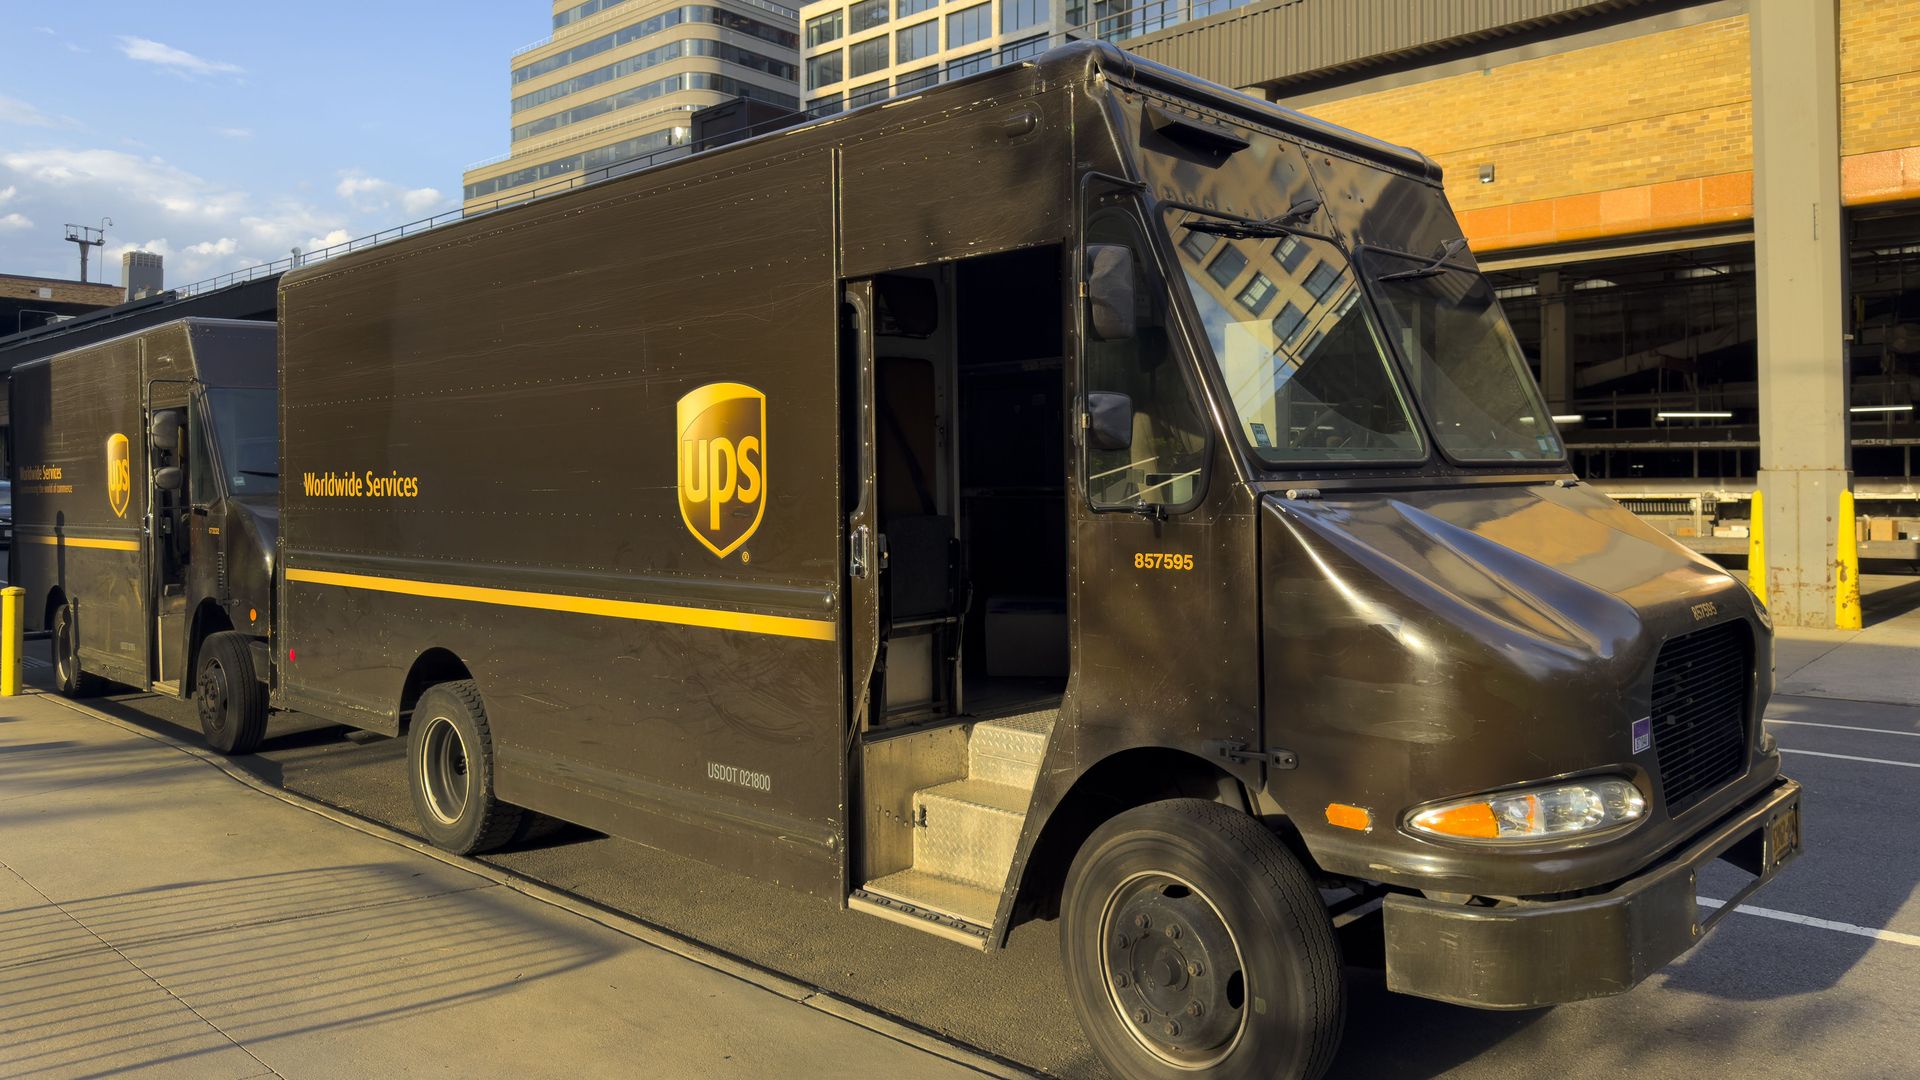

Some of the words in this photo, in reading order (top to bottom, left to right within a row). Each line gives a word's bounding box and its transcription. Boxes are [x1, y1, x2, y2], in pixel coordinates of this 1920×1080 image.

[42, 464, 62, 480] Services
[110, 459, 129, 505] ups
[303, 471, 363, 497] Worldwide
[365, 470, 419, 497] Services
[683, 435, 761, 531] ups
[1134, 552, 1194, 571] 857595
[1690, 601, 1718, 621] 857595
[707, 761, 738, 783] USDOT
[739, 769, 771, 791] 021800
